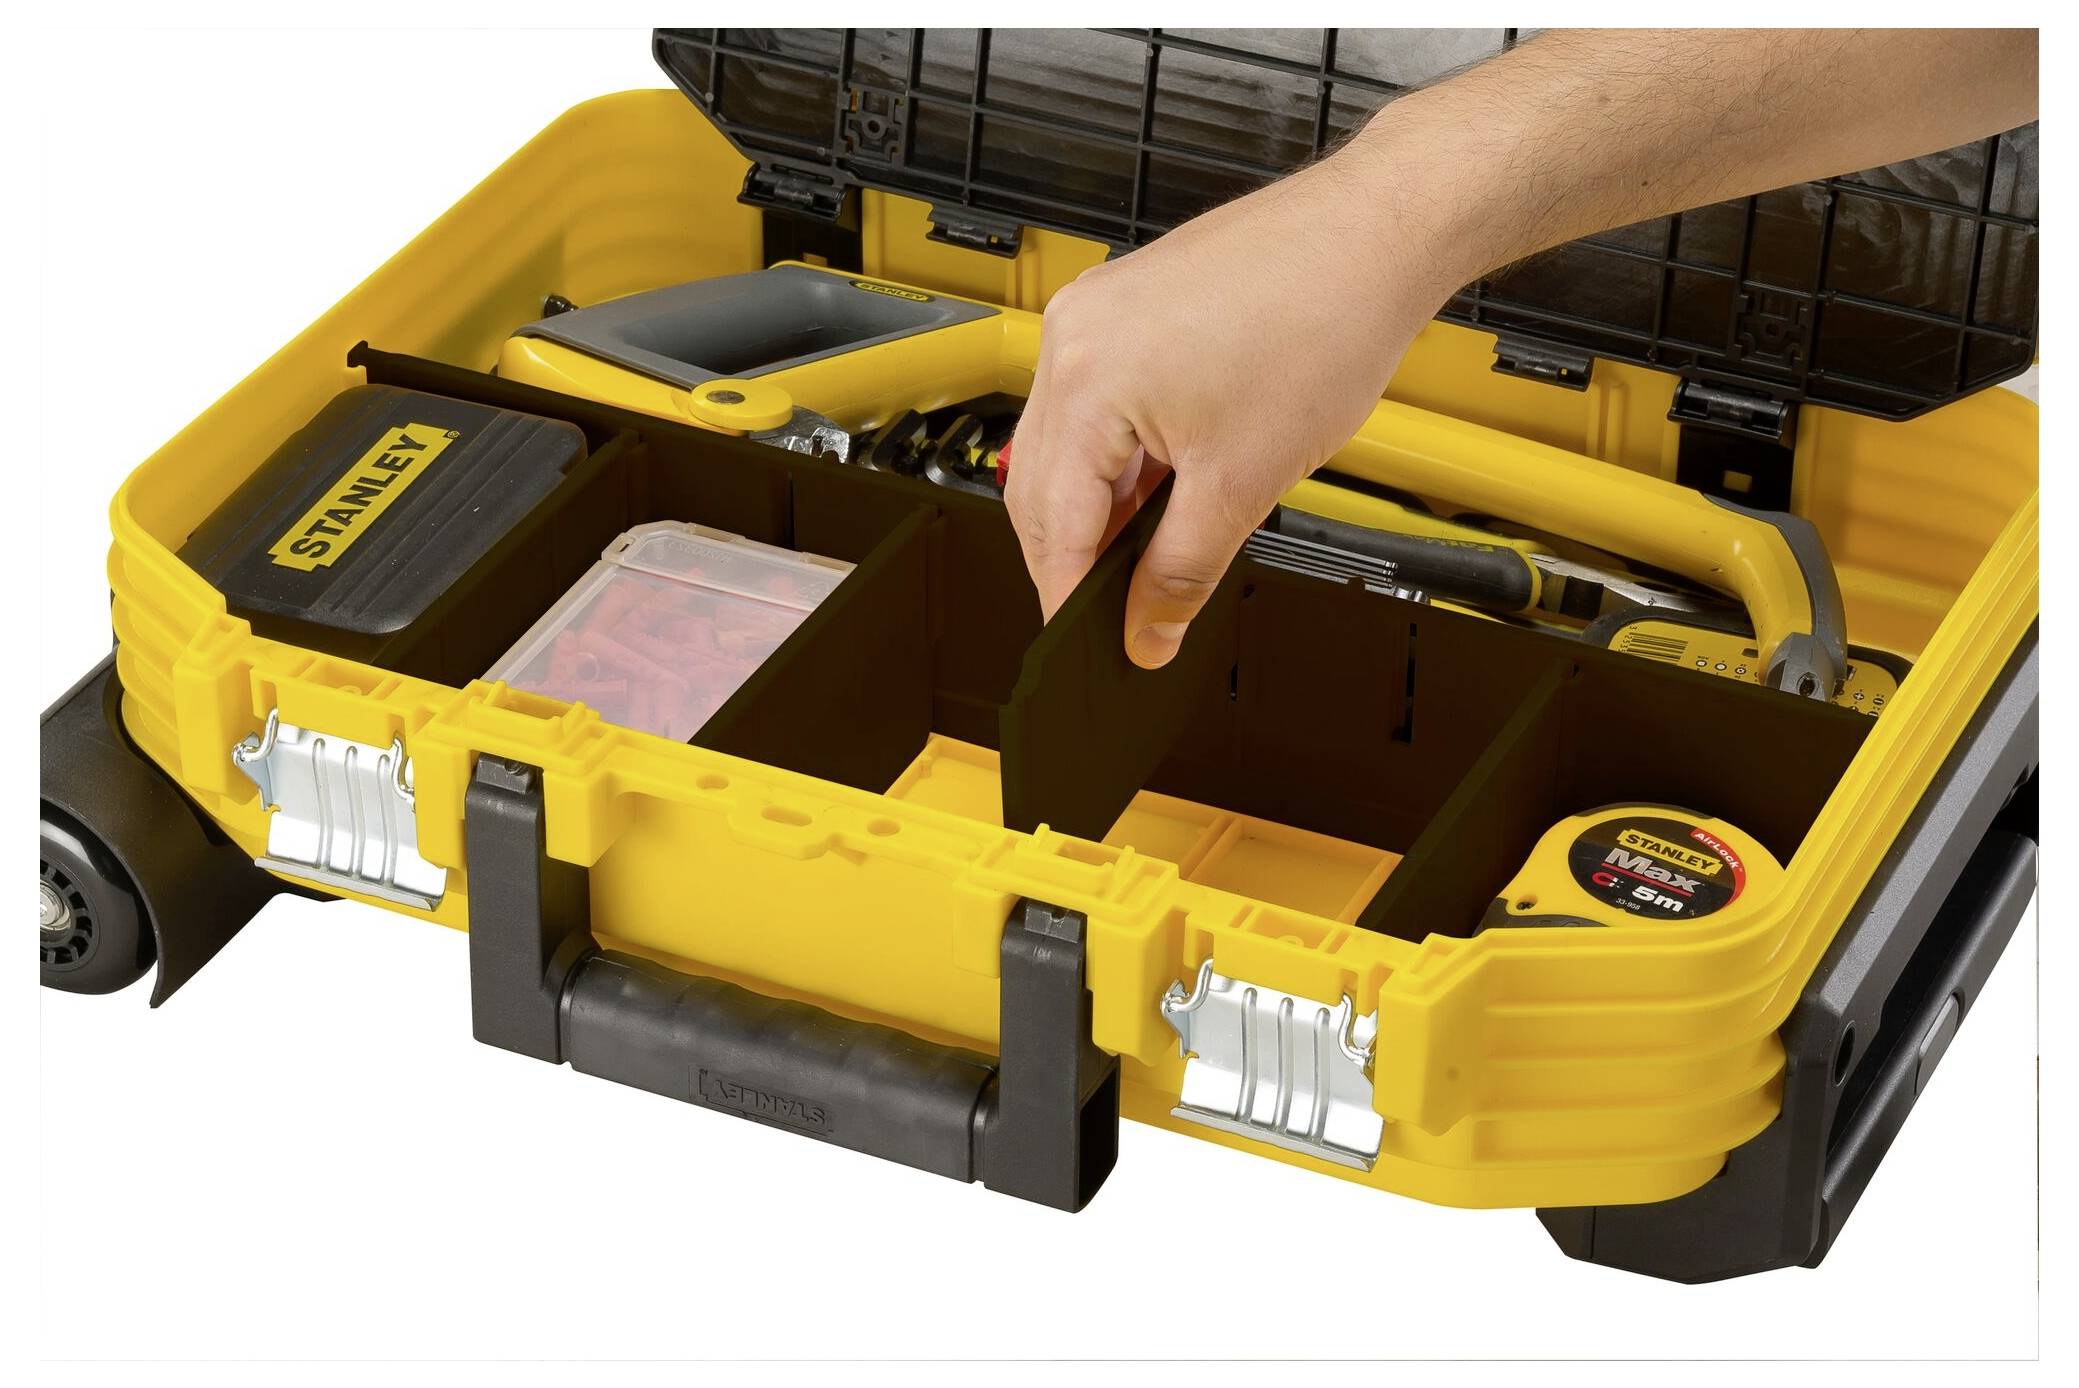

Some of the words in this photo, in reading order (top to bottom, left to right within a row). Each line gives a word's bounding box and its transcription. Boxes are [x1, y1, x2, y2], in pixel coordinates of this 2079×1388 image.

[861, 284, 925, 300] STANLEY
[289, 433, 429, 559] STANLEY
[1605, 848, 1701, 893] Max
[1625, 834, 1716, 870] STANLEY
[1632, 885, 1684, 913] 5m
[713, 1079, 826, 1125] STANLEY
